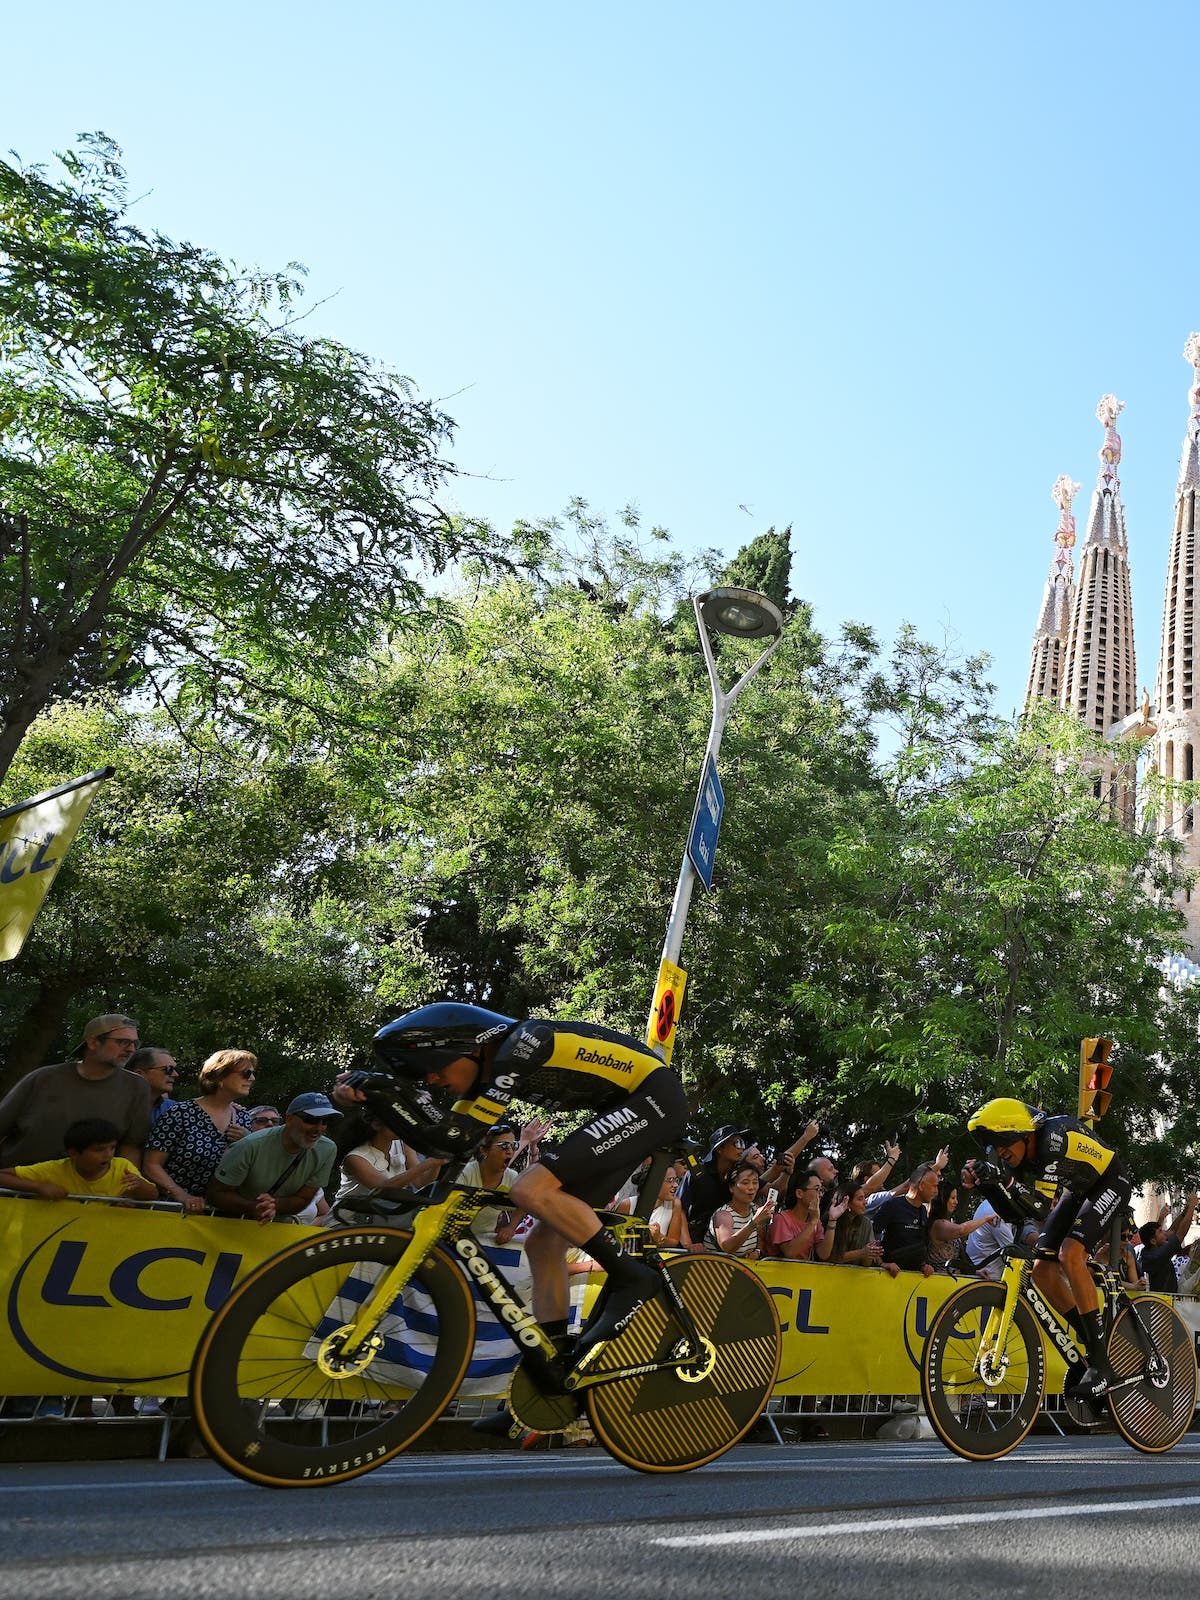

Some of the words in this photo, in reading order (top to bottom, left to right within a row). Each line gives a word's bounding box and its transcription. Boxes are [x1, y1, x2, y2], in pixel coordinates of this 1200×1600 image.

[0, 833, 57, 884] CL
[575, 1047, 634, 1074] Rabobank
[486, 1088, 511, 1103] SKIL
[584, 1107, 638, 1140] VISMA
[1076, 1142, 1103, 1161] Rabobank
[1092, 1188, 1118, 1215] VISMA
[305, 1234, 387, 1257] RESERVE
[1026, 1287, 1080, 1364] cervélo
[619, 1363, 658, 1378] SRAM
[929, 1336, 941, 1392] RESERVE
[303, 1445, 387, 1478] RESERVE
